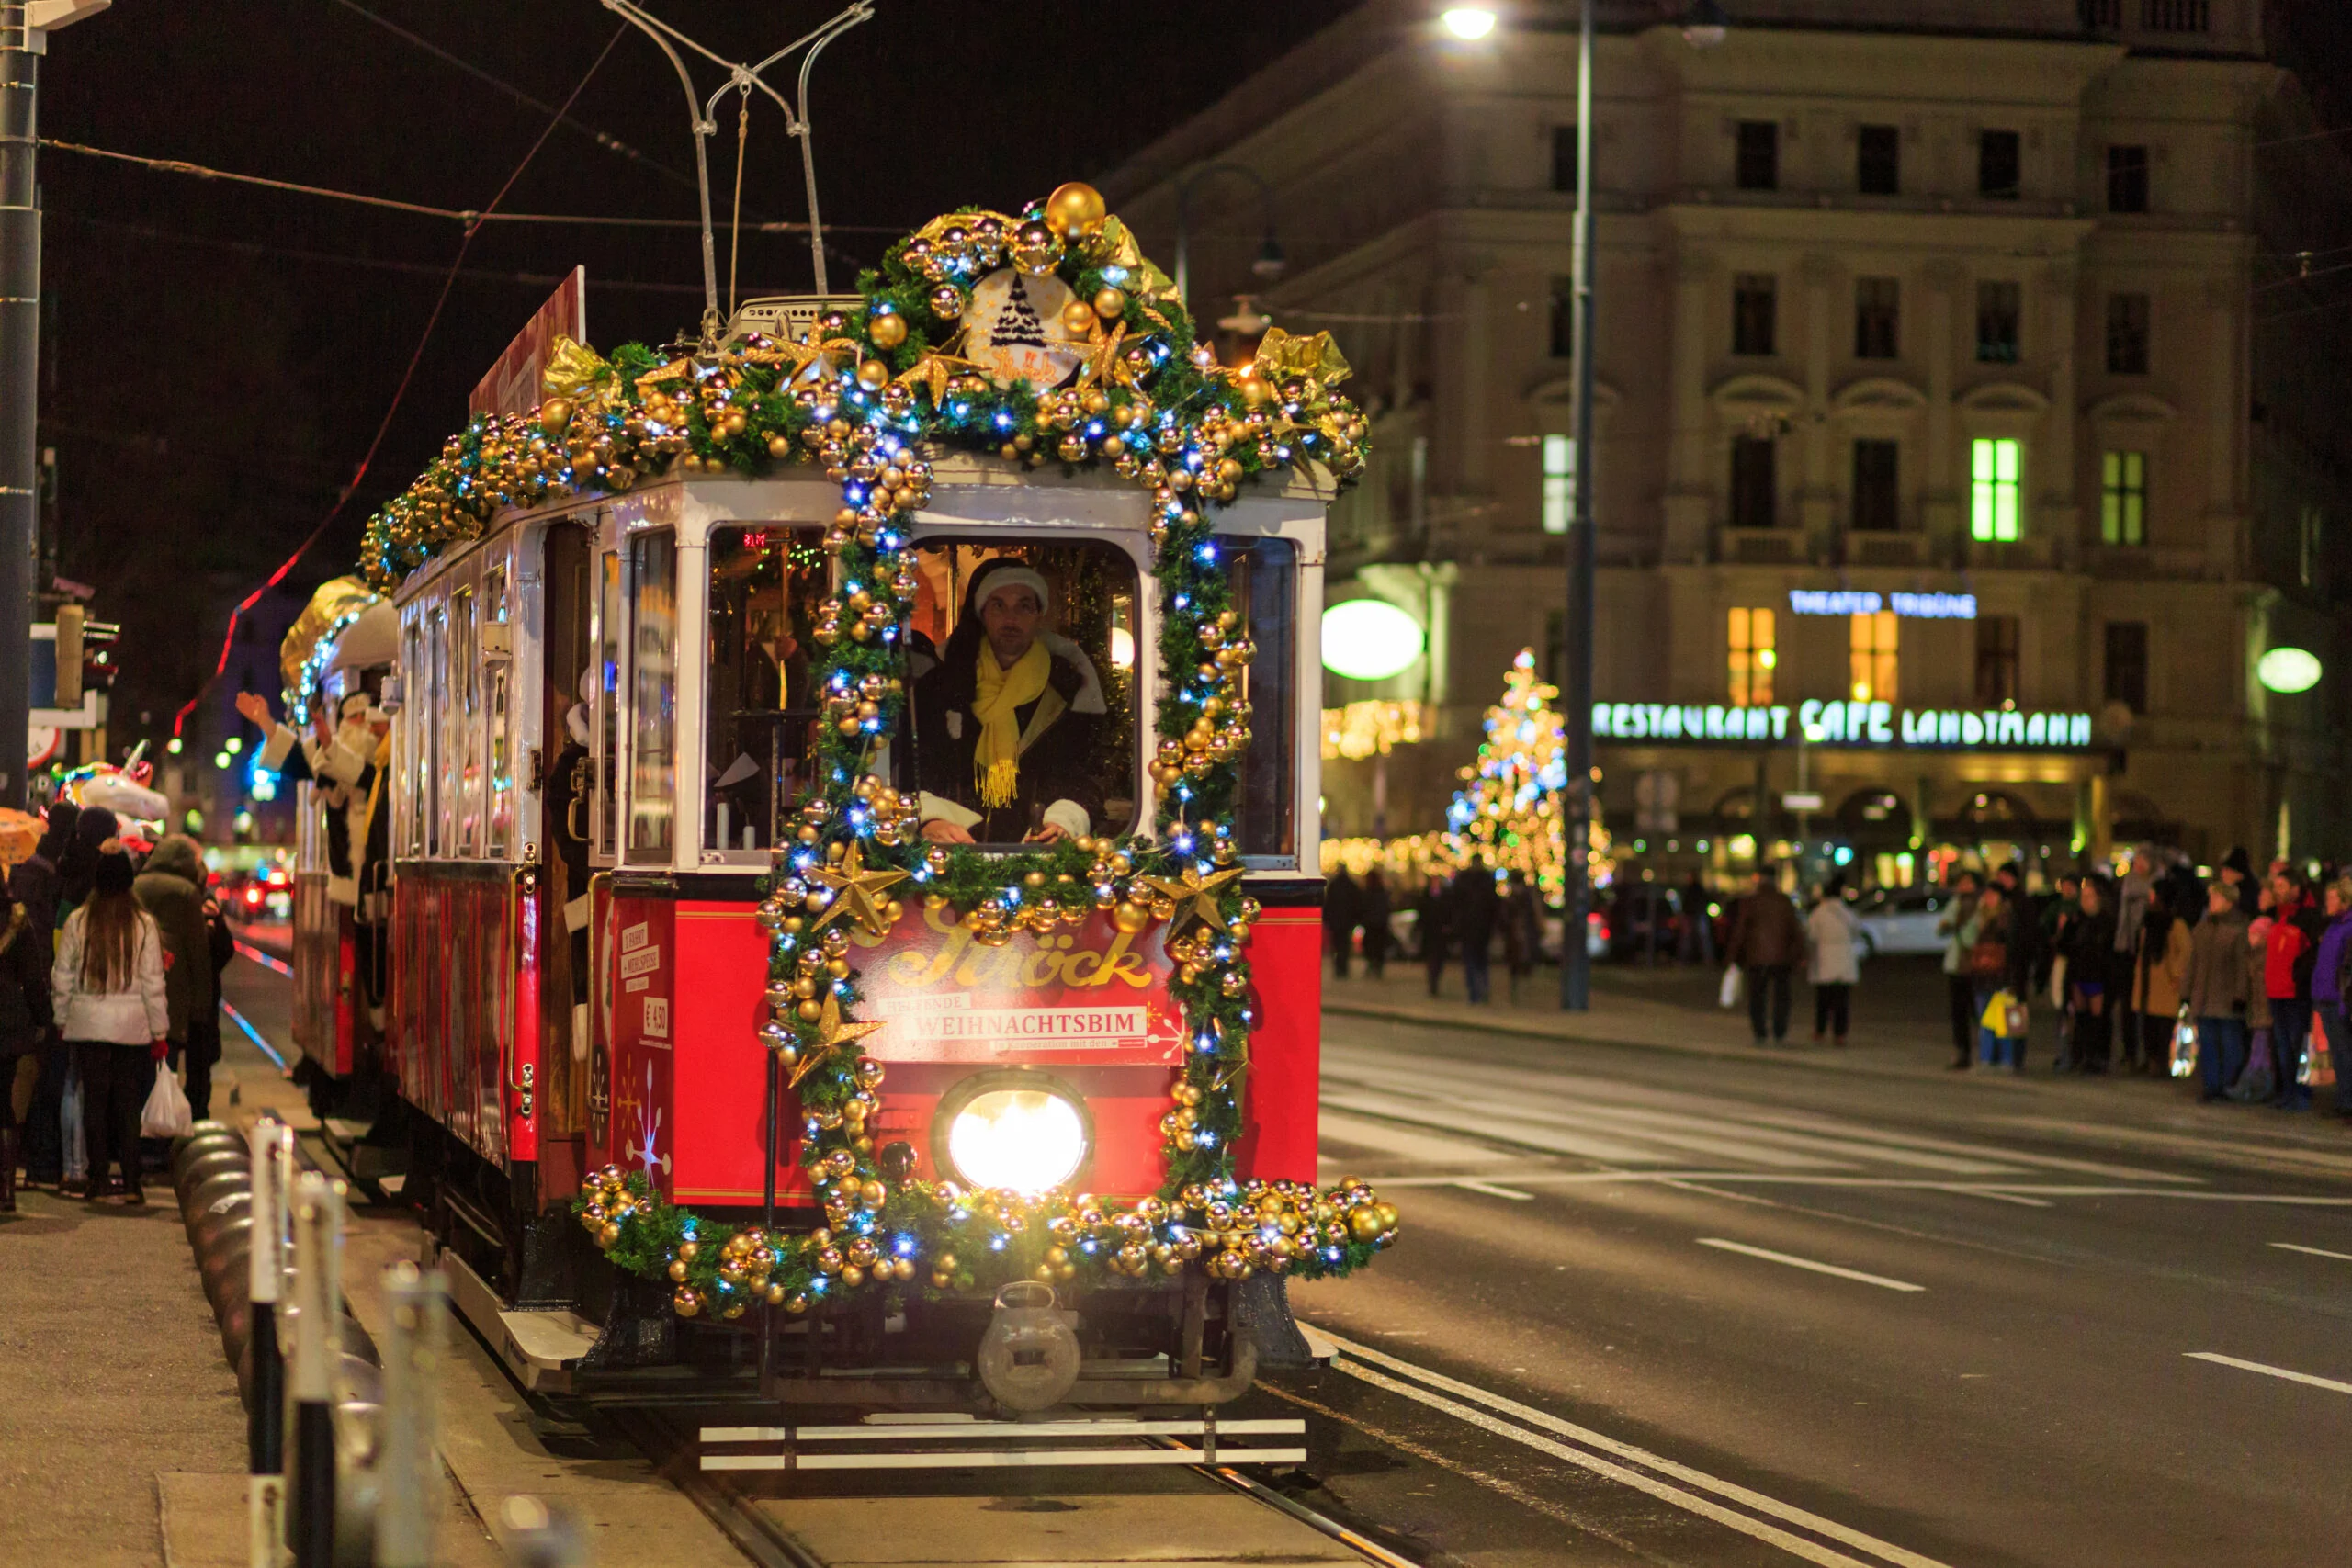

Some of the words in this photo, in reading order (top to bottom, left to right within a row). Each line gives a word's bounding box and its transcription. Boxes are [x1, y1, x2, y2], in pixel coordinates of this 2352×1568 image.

[1592, 703, 1790, 739] RESTAURANT
[1901, 709, 2091, 745] LANDTMANN
[886, 996, 962, 1012] HELFENDE
[646, 1003, 650, 1028] €
[653, 1004, 666, 1032] 4,50
[915, 1014, 1135, 1036] WEIHNACHTSBIM
[1070, 1039, 1087, 1048] mit
[1089, 1038, 1107, 1048] den
